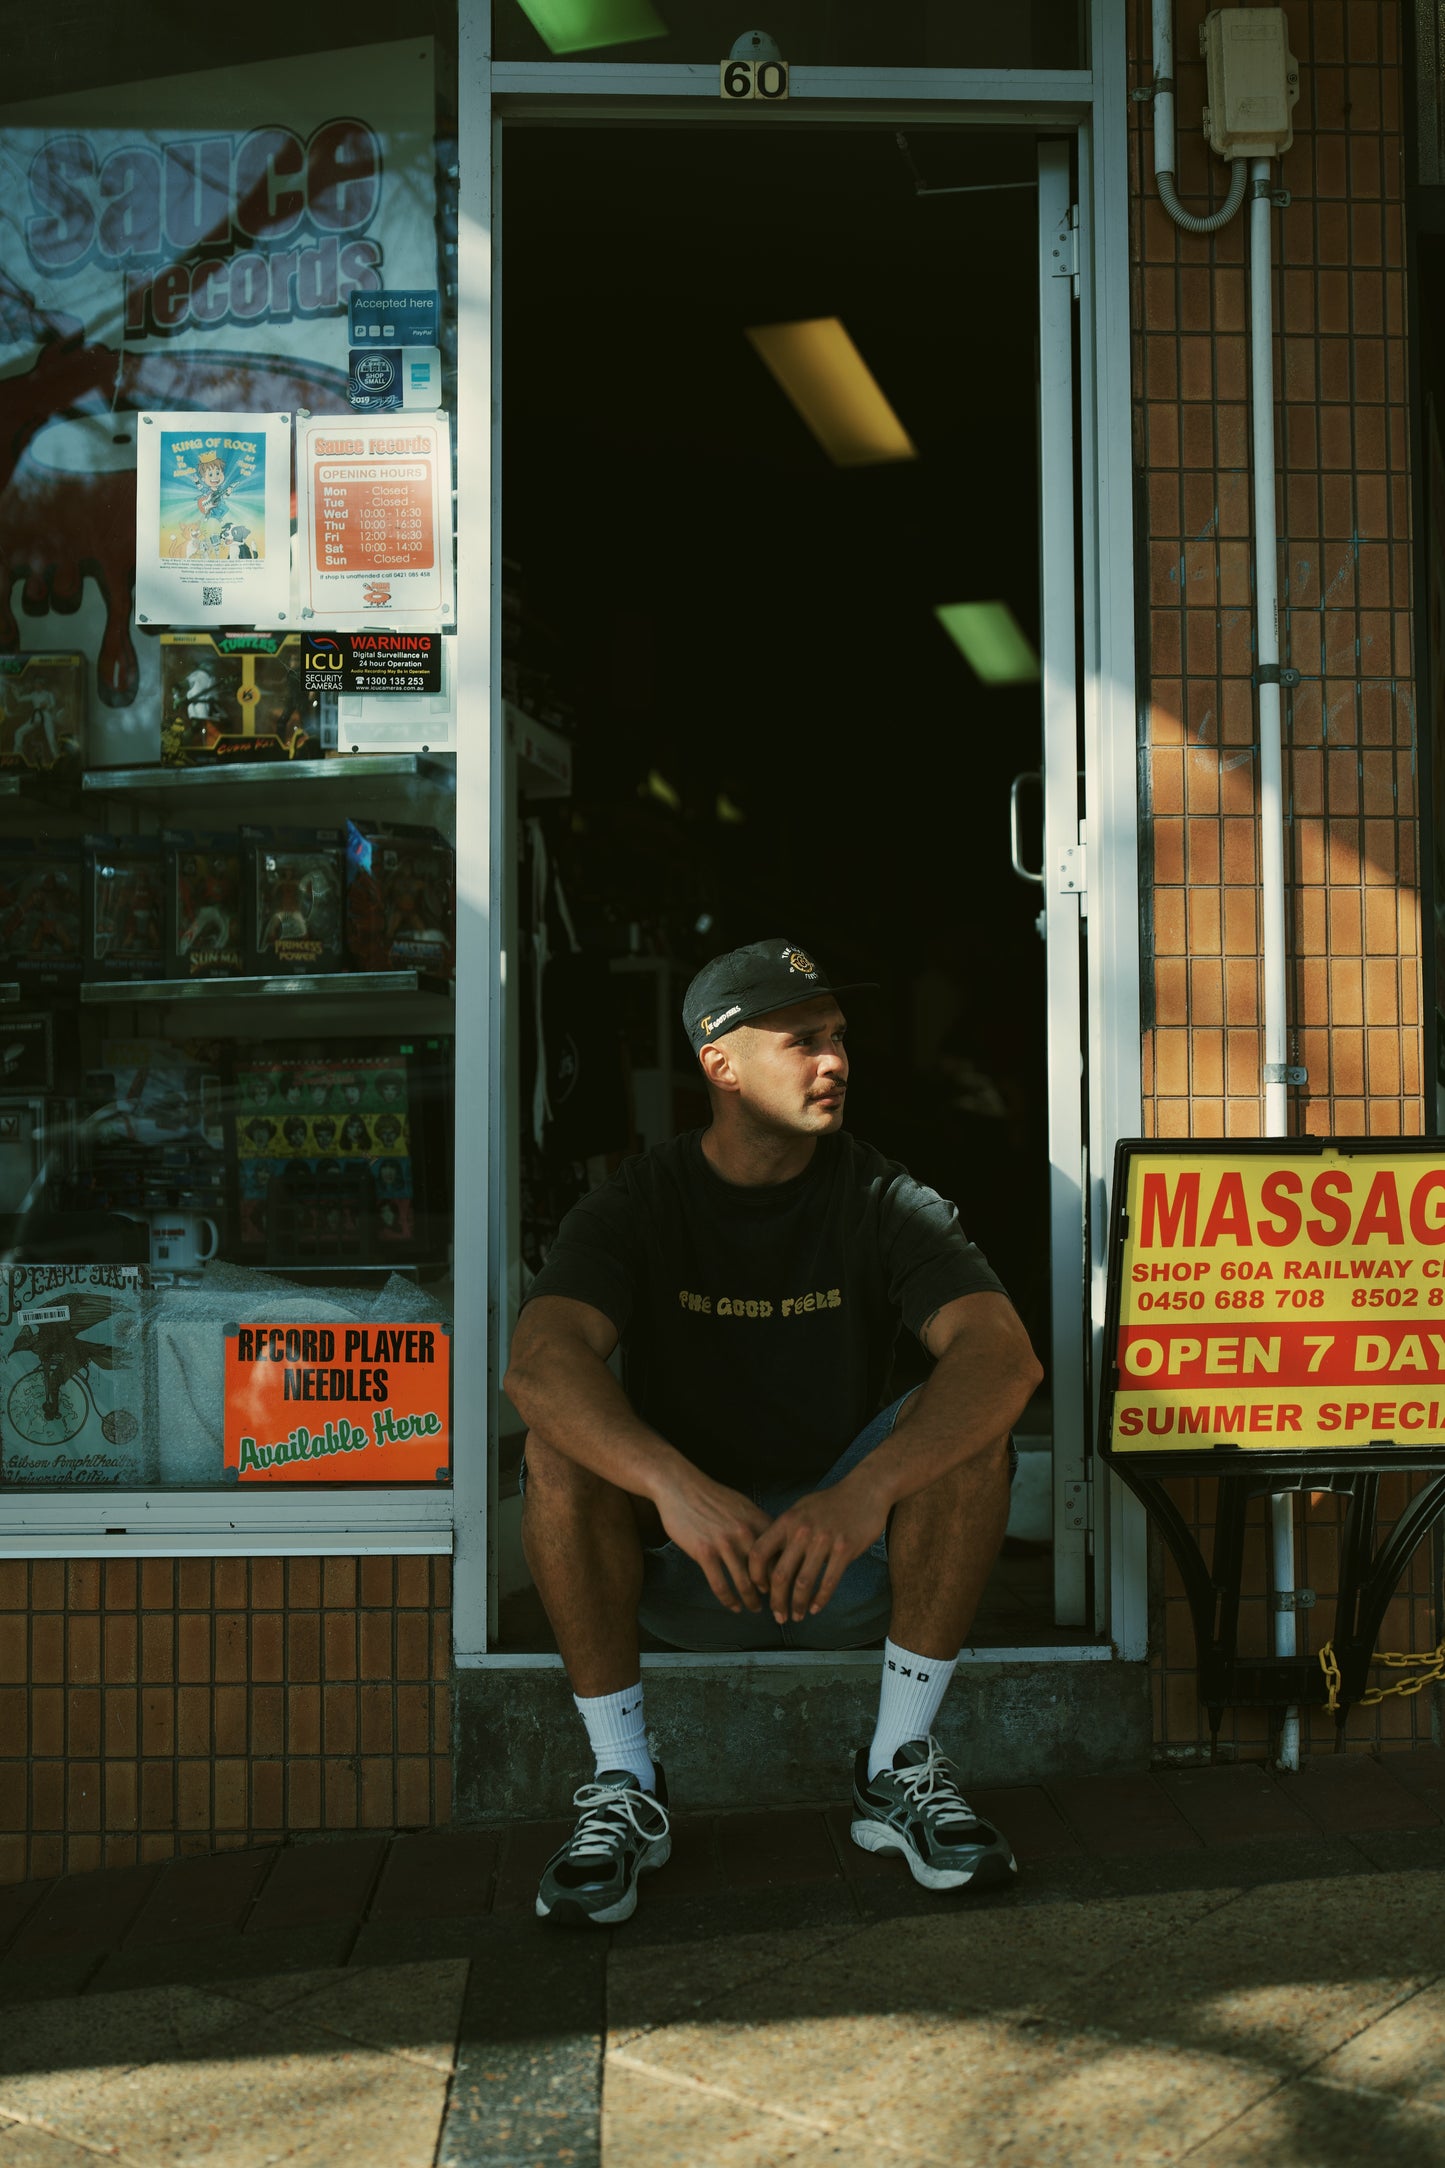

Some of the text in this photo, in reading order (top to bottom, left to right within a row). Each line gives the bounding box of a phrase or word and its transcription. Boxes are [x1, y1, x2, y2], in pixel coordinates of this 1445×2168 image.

[724, 61, 787, 98] 60
[354, 298, 433, 310] Accepted here
[351, 396, 370, 404] 2019
[171, 438, 257, 454] KING OF ROCK
[368, 434, 432, 455] records
[323, 468, 422, 480] OPENING HOURS
[324, 487, 347, 496] Mon
[372, 486, 408, 495] Closed
[324, 499, 345, 508] Tue
[372, 497, 408, 507] Closed
[324, 510, 349, 519] Wed
[359, 509, 385, 518] 10:00
[395, 508, 421, 517] 16:30
[324, 521, 345, 530] Thu
[359, 520, 385, 529] 10:00
[395, 519, 421, 529] 16:30
[325, 533, 339, 542] Fri
[360, 531, 386, 541] 12:00
[396, 531, 422, 540] 16:30
[325, 544, 344, 554] Sat
[360, 543, 386, 552] 10:00
[397, 542, 422, 551] 14:00
[326, 556, 347, 565] Sun
[373, 554, 410, 563] Closed
[351, 636, 432, 651] WARNING
[377, 651, 421, 659] Surveillance
[305, 653, 343, 670] ICU
[305, 674, 343, 682] SECURITY
[366, 677, 424, 685] 1300 135 253
[305, 682, 343, 690] CAMERAS
[1131, 1262, 1211, 1282] SHOP
[1220, 1261, 1274, 1280] 60A
[1283, 1259, 1413, 1280] RAILWAY
[4, 1265, 86, 1314] PEARL
[1137, 1291, 1205, 1311] 0450
[1214, 1289, 1265, 1309] 688
[1275, 1289, 1325, 1308] 708
[1351, 1287, 1419, 1307] 8502
[238, 1328, 435, 1363] RECORD PLAYER
[1124, 1336, 1282, 1376] OPEN
[1303, 1335, 1335, 1373] 7
[284, 1368, 388, 1402] NEEDLES
[1118, 1401, 1445, 1436] SUMMER SPECI
[238, 1408, 442, 1473] Available Here
